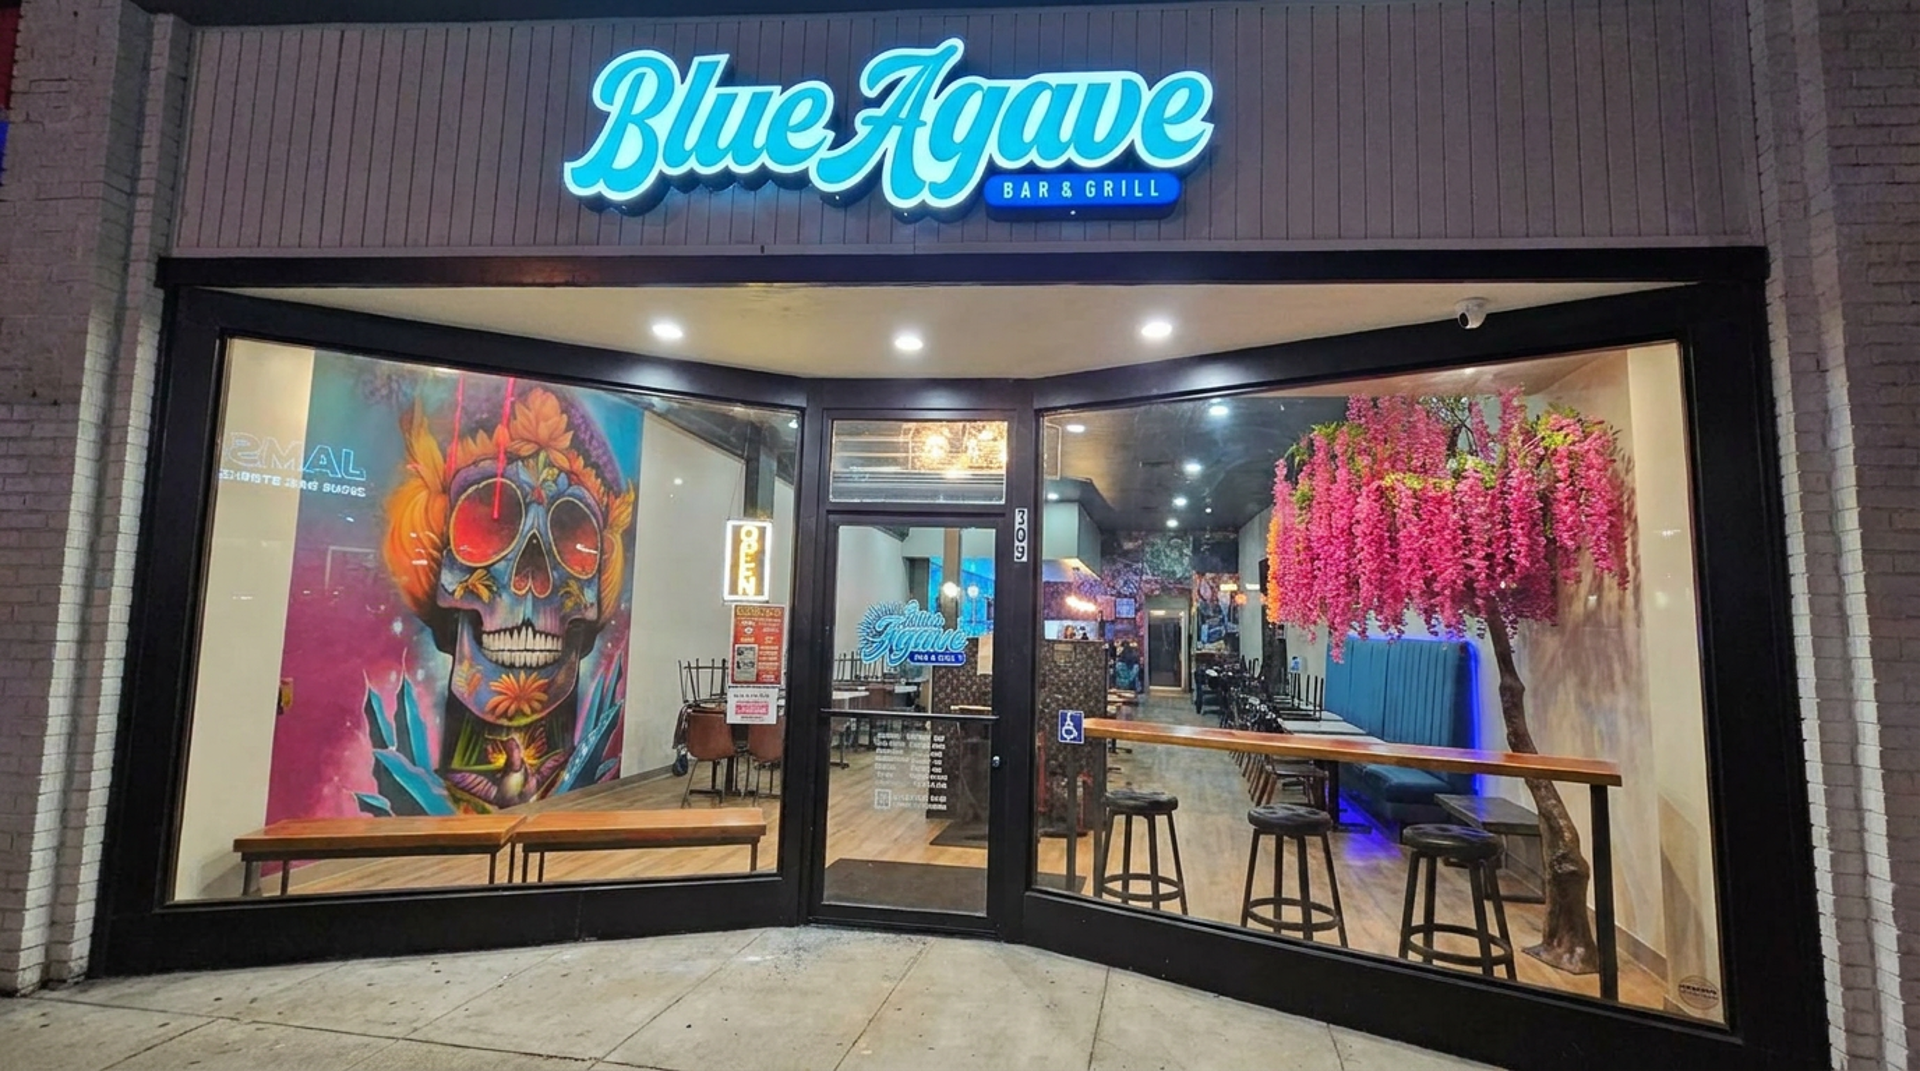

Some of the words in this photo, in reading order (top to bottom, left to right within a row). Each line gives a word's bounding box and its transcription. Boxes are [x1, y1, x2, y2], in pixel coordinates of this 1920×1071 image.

[565, 49, 834, 200] Blue
[808, 38, 1214, 207] Agave
[1003, 181, 1049, 198] BAR
[1061, 180, 1073, 198] &
[1085, 179, 1159, 197] GRILL
[738, 525, 759, 596] OPEN
[1015, 509, 1026, 560] 309
